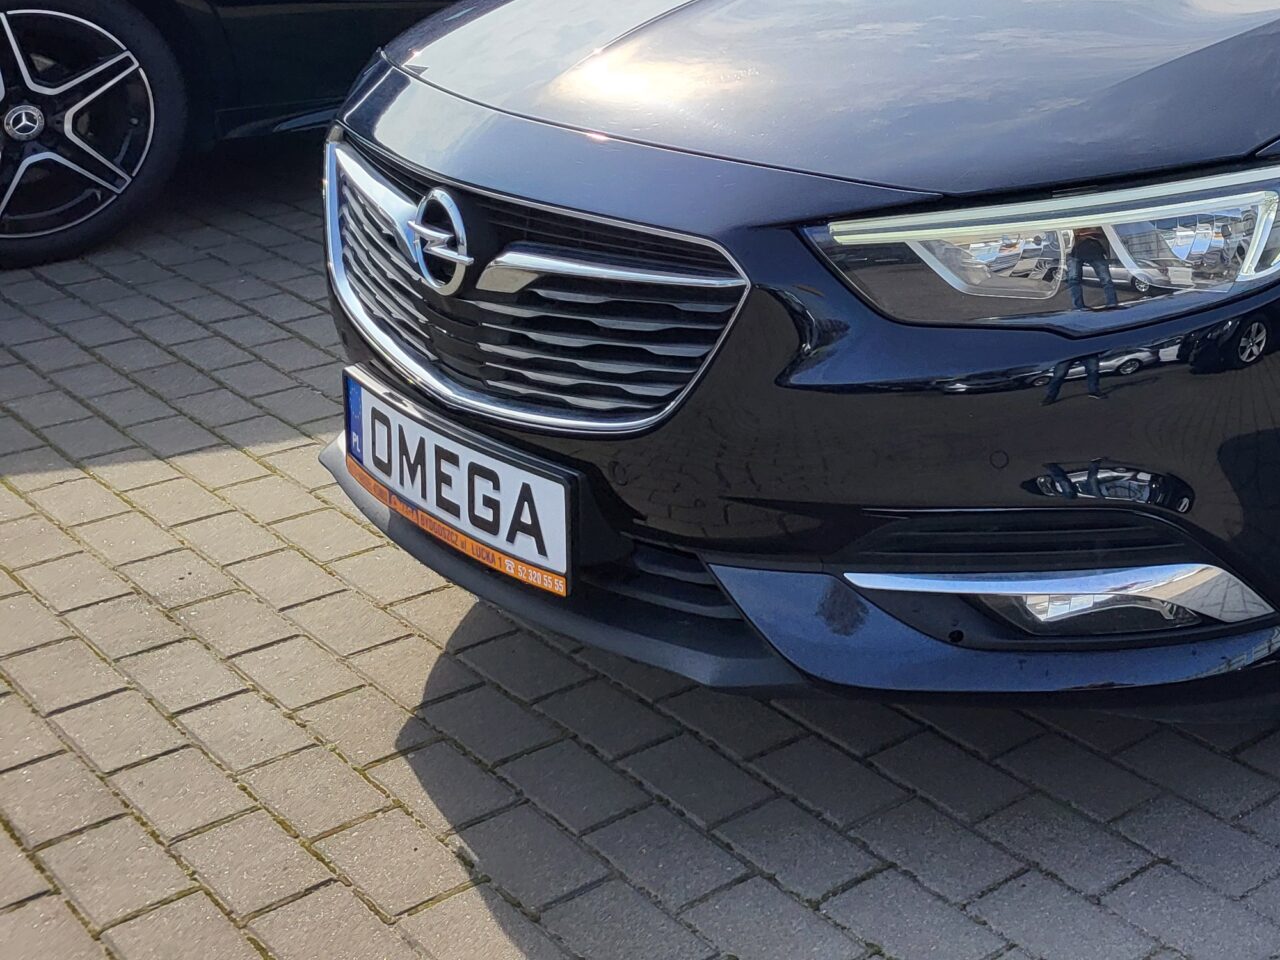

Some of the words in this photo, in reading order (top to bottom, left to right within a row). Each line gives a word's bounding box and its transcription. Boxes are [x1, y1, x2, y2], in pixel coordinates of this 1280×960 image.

[352, 431, 361, 453] PL
[371, 406, 548, 557] OMEGA
[517, 564, 527, 580] 52
[527, 568, 542, 585] 320
[543, 574, 553, 589] 55
[554, 578, 564, 593] 55
